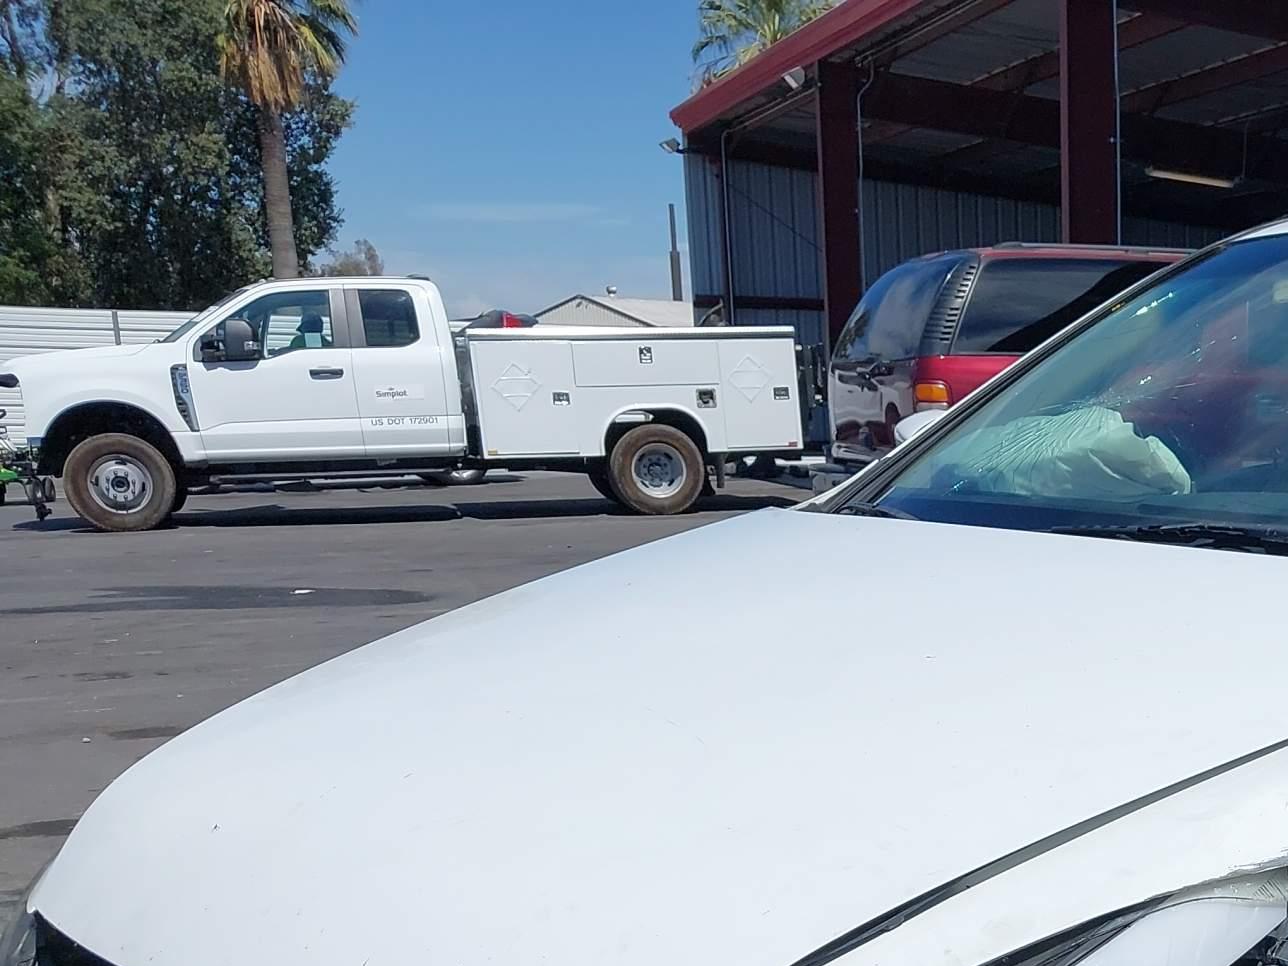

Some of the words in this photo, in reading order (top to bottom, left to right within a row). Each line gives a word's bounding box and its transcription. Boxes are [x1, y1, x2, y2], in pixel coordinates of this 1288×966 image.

[375, 390, 408, 399] Simplot
[370, 418, 384, 426] US
[387, 418, 404, 426] DOT
